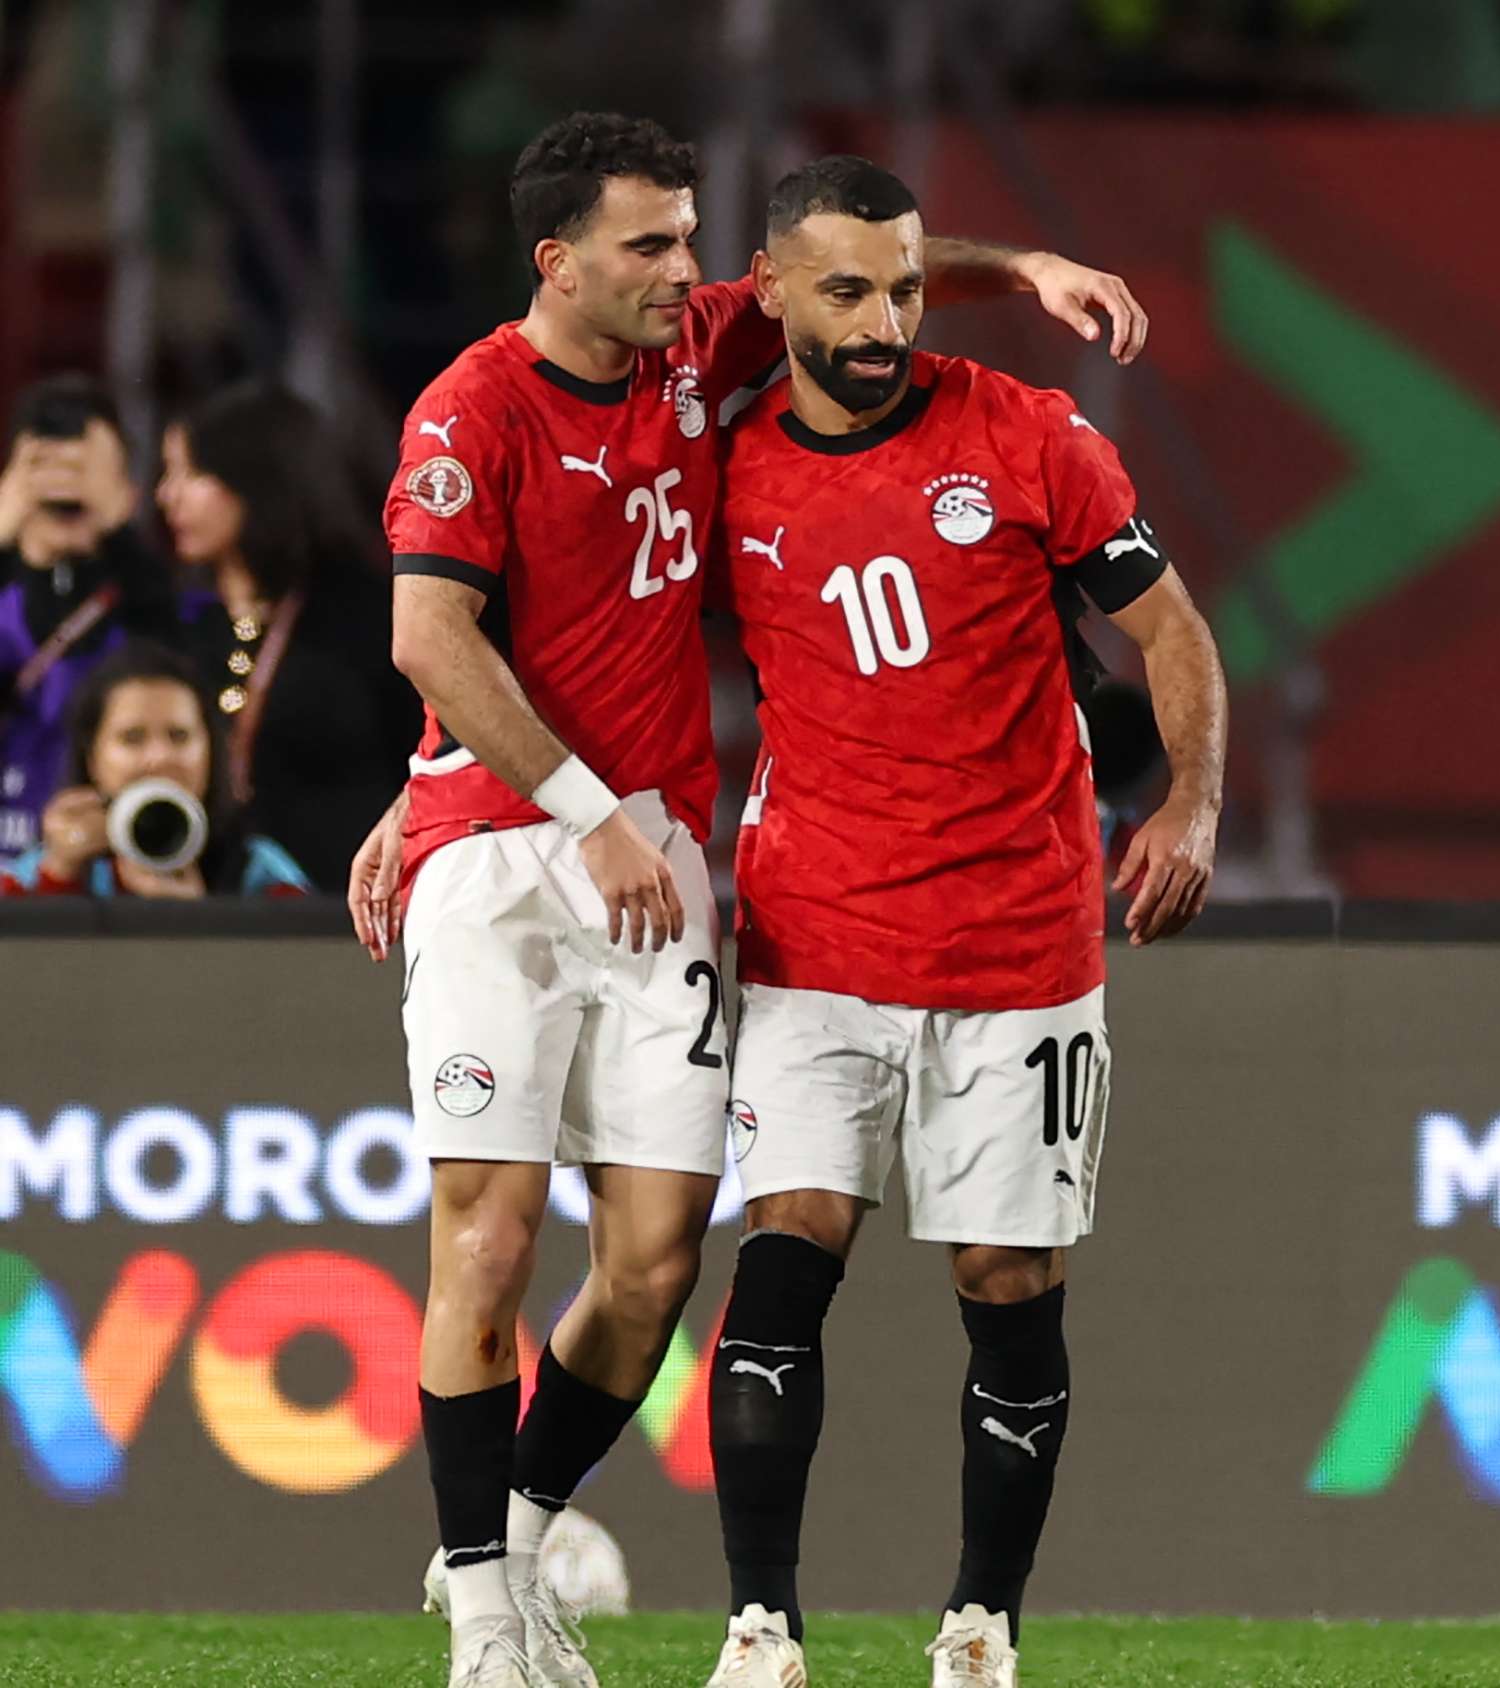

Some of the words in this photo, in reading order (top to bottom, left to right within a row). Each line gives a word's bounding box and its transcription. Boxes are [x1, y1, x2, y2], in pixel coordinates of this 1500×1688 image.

[624, 467, 699, 600] 25
[820, 555, 931, 676] 10
[684, 959, 730, 1069] 2
[1025, 1031, 1094, 1147] 10
